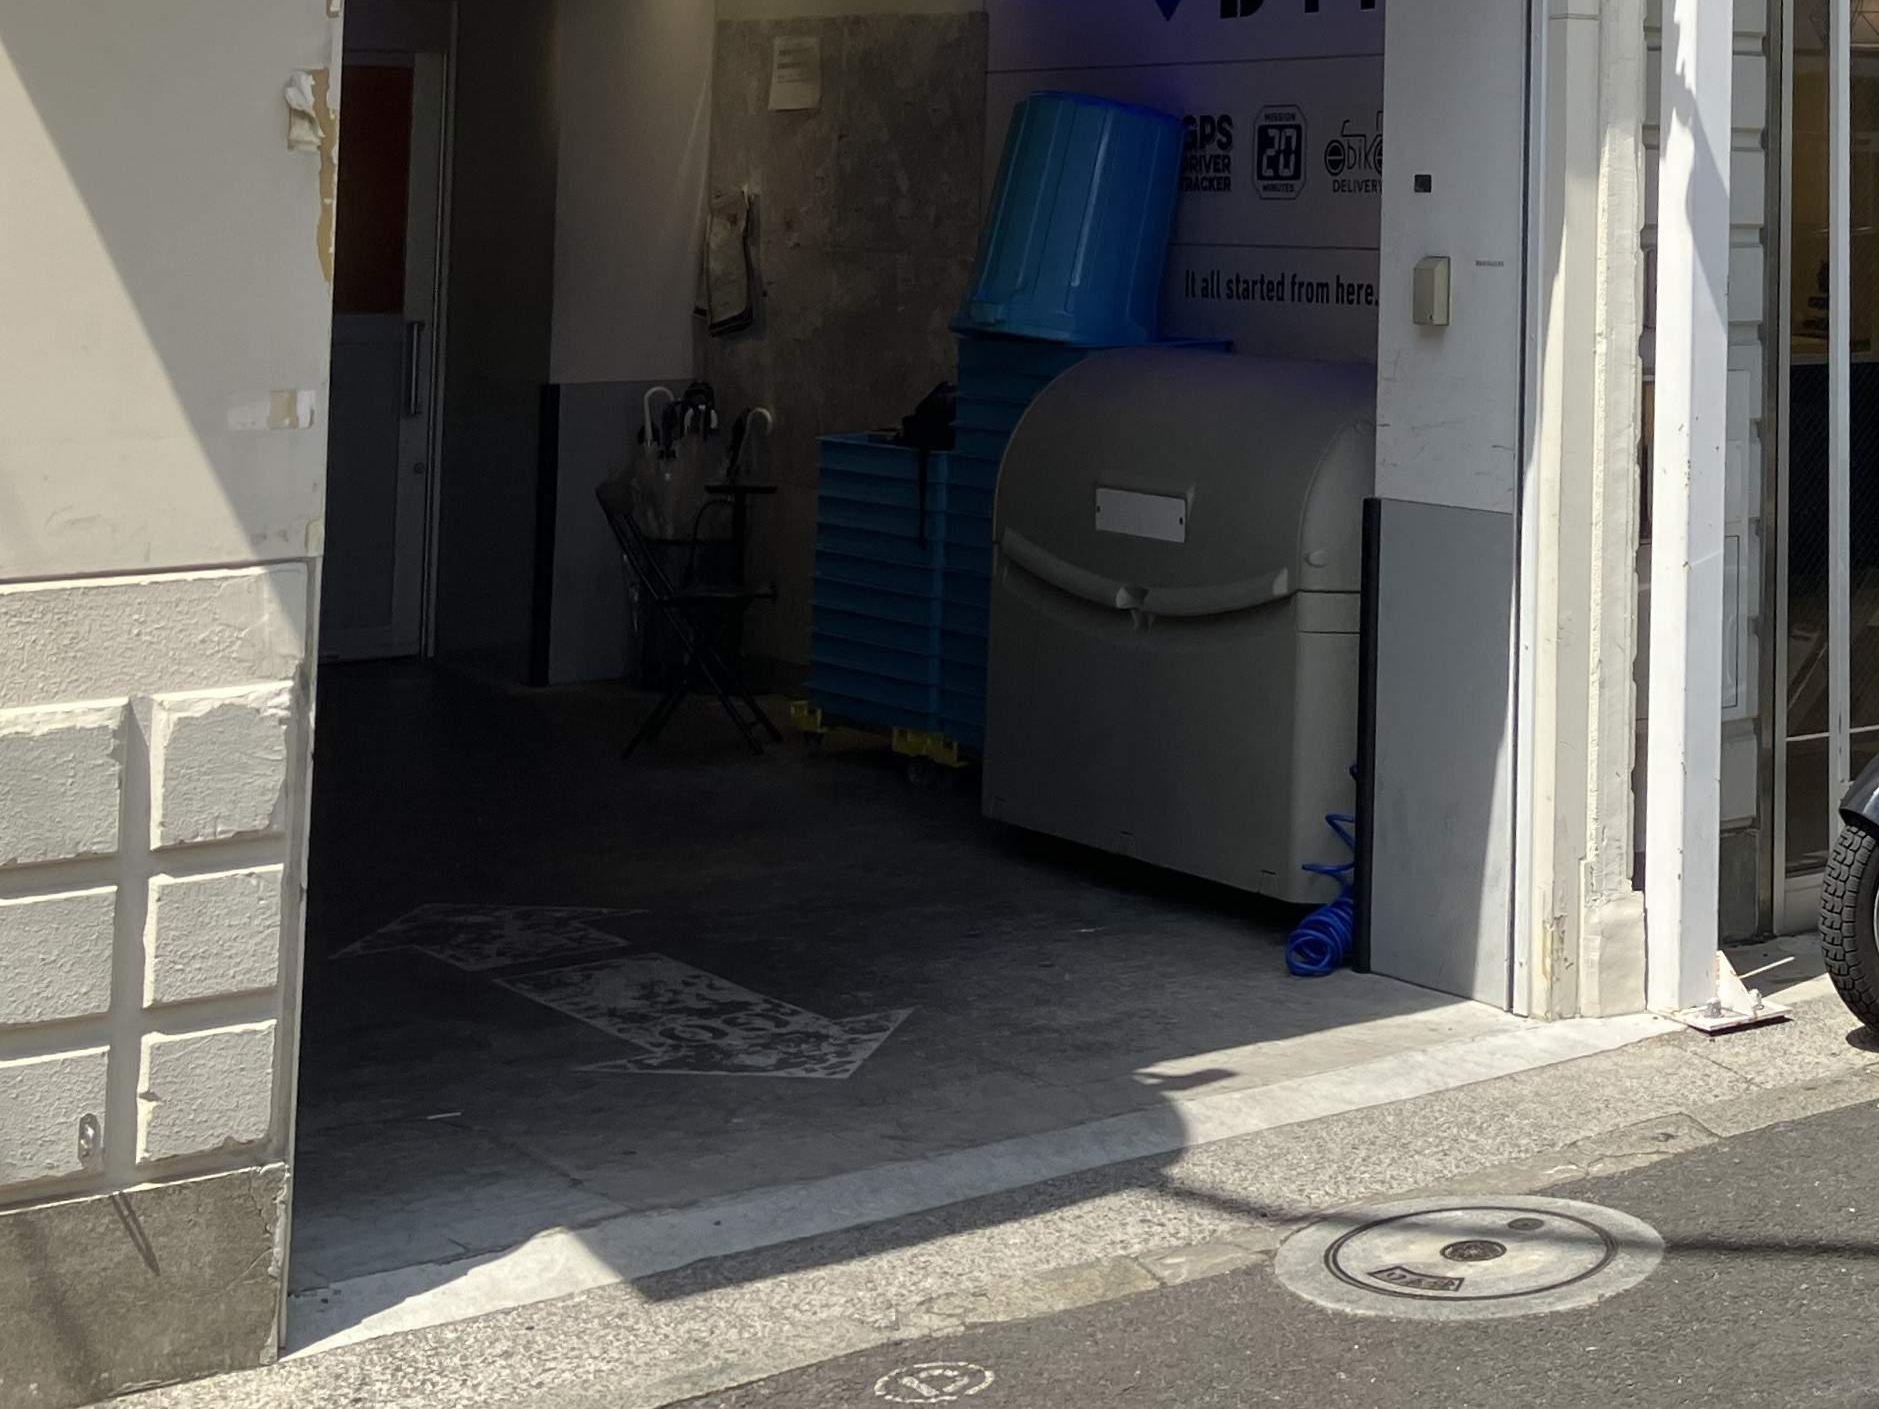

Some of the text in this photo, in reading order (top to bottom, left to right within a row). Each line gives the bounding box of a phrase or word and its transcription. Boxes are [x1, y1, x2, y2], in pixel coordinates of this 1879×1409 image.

[1260, 128, 1297, 177] 20
[1184, 269, 1380, 307] It all started from here.
